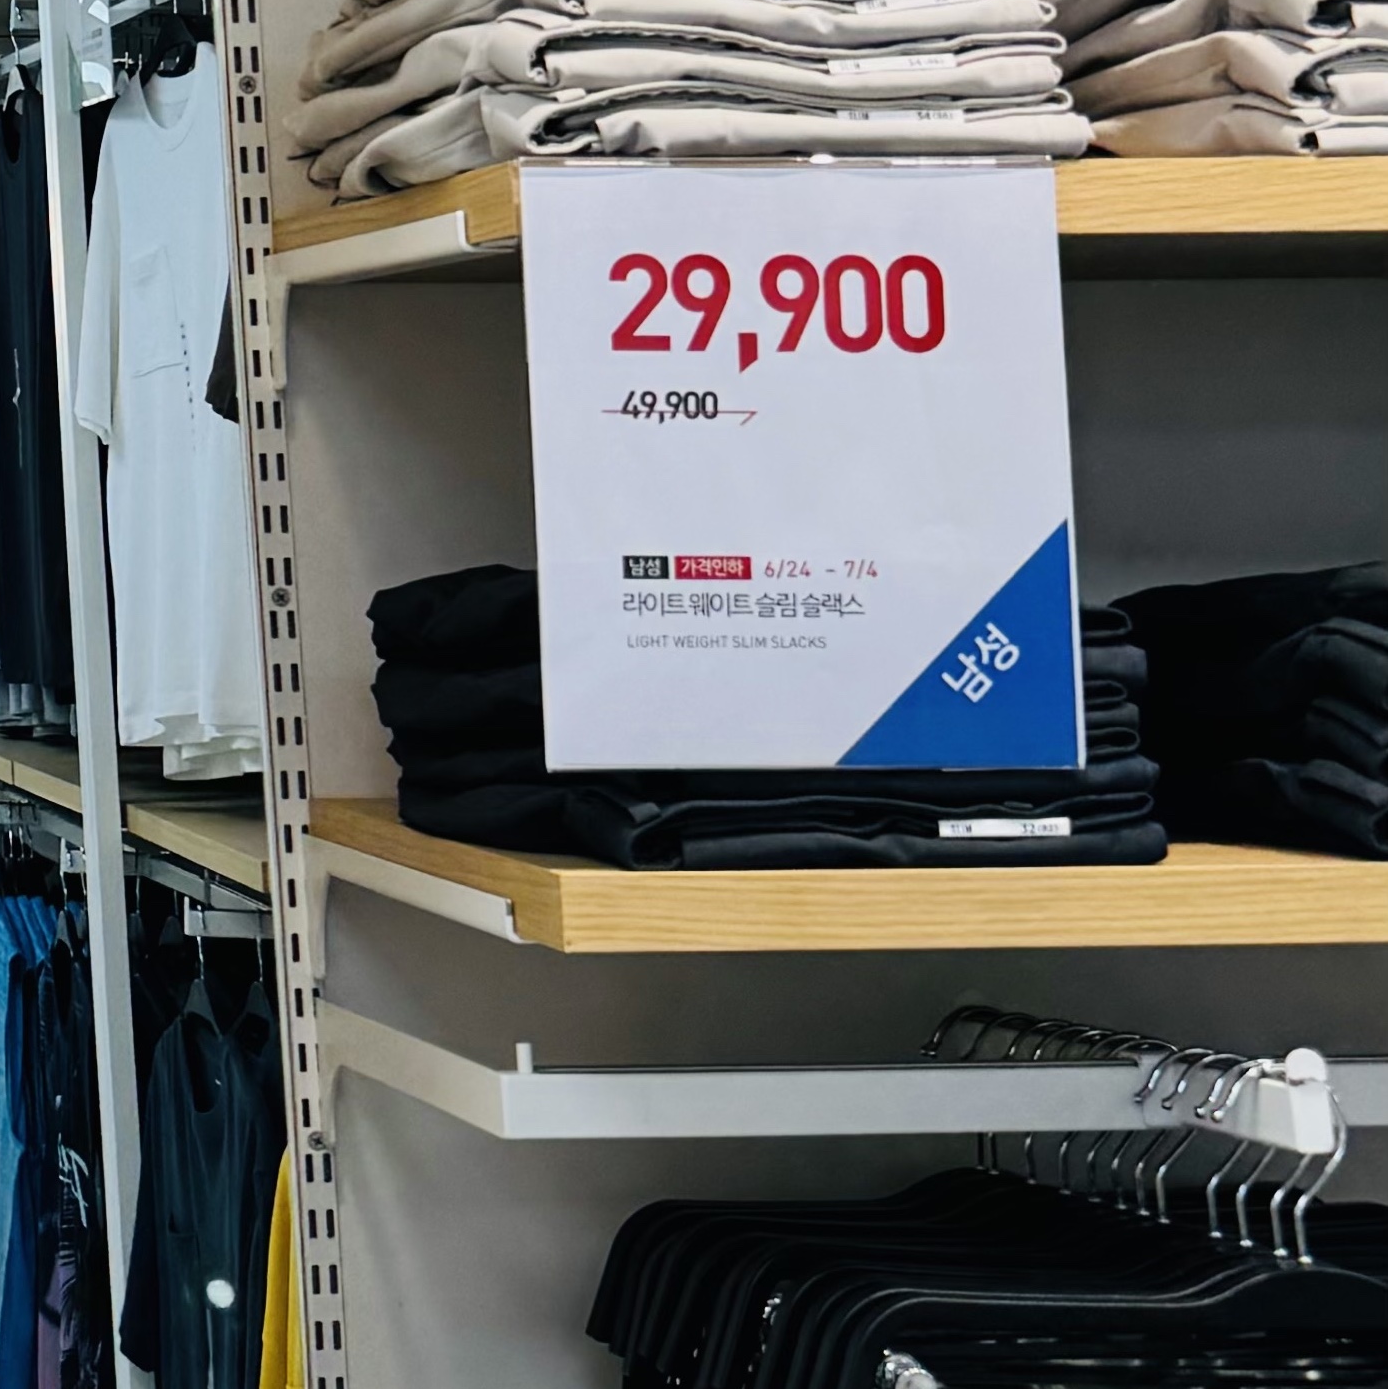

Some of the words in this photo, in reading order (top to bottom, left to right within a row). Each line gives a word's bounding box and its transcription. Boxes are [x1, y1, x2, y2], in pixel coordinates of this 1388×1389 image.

[608, 252, 946, 374] 29,900
[620, 390, 719, 424] 49,900
[628, 558, 662, 577] 남성
[680, 558, 745, 578] 가격인하
[764, 559, 811, 579] 6/24
[843, 559, 878, 579] 7/4
[800, 592, 867, 618] 슬랙스
[626, 635, 669, 650] LIGHT
[672, 635, 729, 650] WEIGHT
[731, 636, 768, 650] SLIM
[770, 636, 828, 650] SLACKS
[941, 621, 1020, 703] 남성
